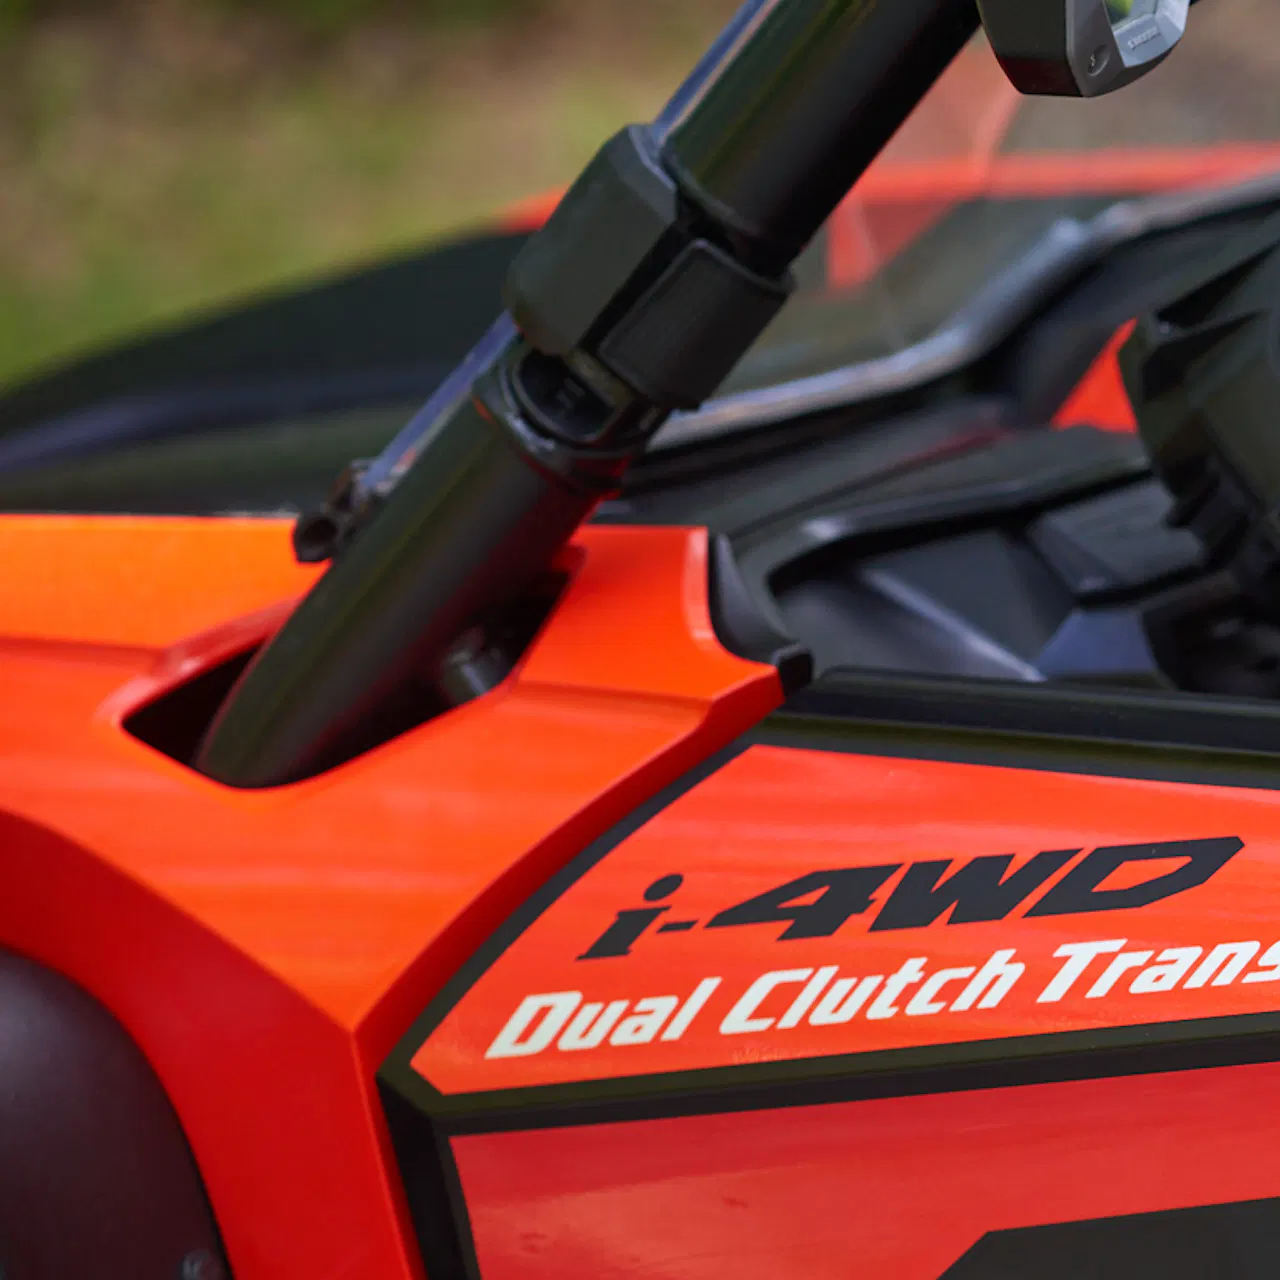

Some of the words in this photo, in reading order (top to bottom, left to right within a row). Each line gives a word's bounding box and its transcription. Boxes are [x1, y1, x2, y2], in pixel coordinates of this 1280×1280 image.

[577, 836, 1245, 961] i-4WD
[486, 977, 722, 1058] Dual
[719, 948, 1026, 1034] Clutch
